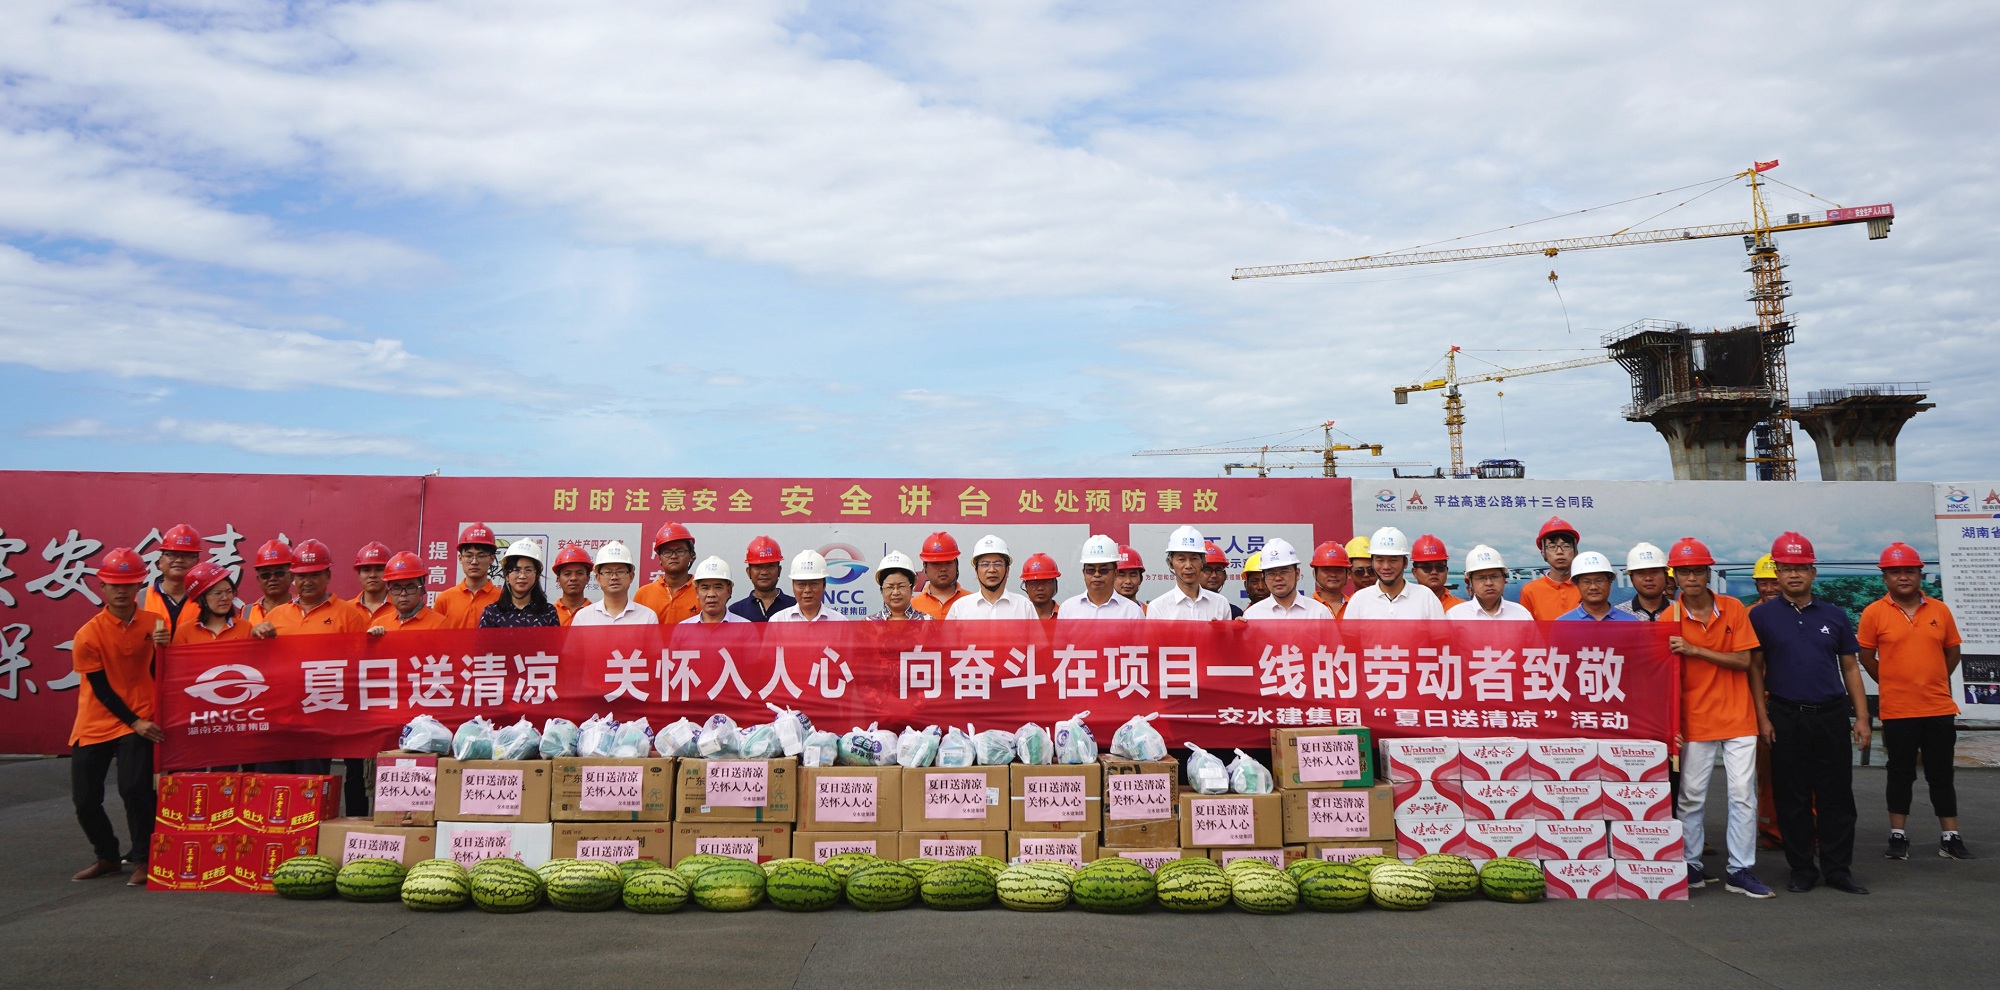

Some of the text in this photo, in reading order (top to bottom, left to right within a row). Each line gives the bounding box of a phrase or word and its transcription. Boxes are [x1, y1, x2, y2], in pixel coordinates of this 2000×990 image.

[553, 485, 1219, 517] 时时注意安全 安全讲台 处处预防事故
[1433, 495, 1594, 509] 平益高速公路第十三合同段
[557, 539, 624, 550] 安全生产四不
[821, 589, 864, 605] NCC
[301, 644, 1626, 713] 夏日送清凉 关怀入人心 向奋斗在项目一线的劳动者致敬
[190, 707, 266, 725] HNCC
[187, 722, 270, 736] 湖南交水建集团
[1301, 740, 1354, 754] 夏日送清凉
[1401, 745, 1446, 755] Wahaha
[1473, 745, 1514, 758] 娃哈哈
[1540, 745, 1585, 754] Wahaha
[1610, 746, 1656, 756] Wahaha
[1302, 754, 1356, 768] 关怀入人心
[379, 771, 432, 783] 夏日送清凉
[585, 771, 639, 783] 夏日送清凉
[710, 766, 764, 779] 夏日送清凉
[465, 774, 519, 787] 夏日送清凉
[709, 781, 764, 793] 关怀入人心
[928, 778, 982, 791] 夏日送清凉
[1028, 781, 1081, 793] 夏日送清凉
[1113, 778, 1166, 792] 夏日送清凉
[379, 785, 431, 797] 关怀入人心
[584, 785, 638, 798] 关怀入人心
[819, 782, 873, 794] 夏日送清凉
[1478, 784, 1519, 798] 娃哈哈
[1544, 784, 1589, 794] Wahaha
[1616, 785, 1658, 799] 娃哈哈
[464, 789, 518, 801] 关怀入人心
[928, 792, 983, 805] 关怀入人心
[1114, 793, 1167, 806] 关怀入人心
[819, 796, 873, 808] 关怀入人心
[1028, 796, 1082, 808] 关怀入人心
[1312, 796, 1365, 809] 夏日送清凉
[1195, 803, 1249, 816] 夏日送清凉
[1312, 811, 1366, 823] 关怀入人心
[1196, 819, 1250, 831] 关怀入人心
[1411, 822, 1452, 836] 娃哈哈
[1477, 823, 1522, 833] Wahaha
[1547, 824, 1593, 834] Wahaha
[1623, 824, 1669, 835] Wahaha
[348, 838, 401, 852] 夏日送清凉
[453, 835, 507, 848] 夏日送清凉
[580, 845, 635, 858] 夏日送清凉
[699, 842, 754, 856] 夏日送清凉
[923, 845, 977, 857] 夏日送清凉
[1024, 843, 1078, 856] 夏日送清凉
[1560, 863, 1602, 876] 娃哈哈
[1628, 863, 1674, 874] Wahaha
